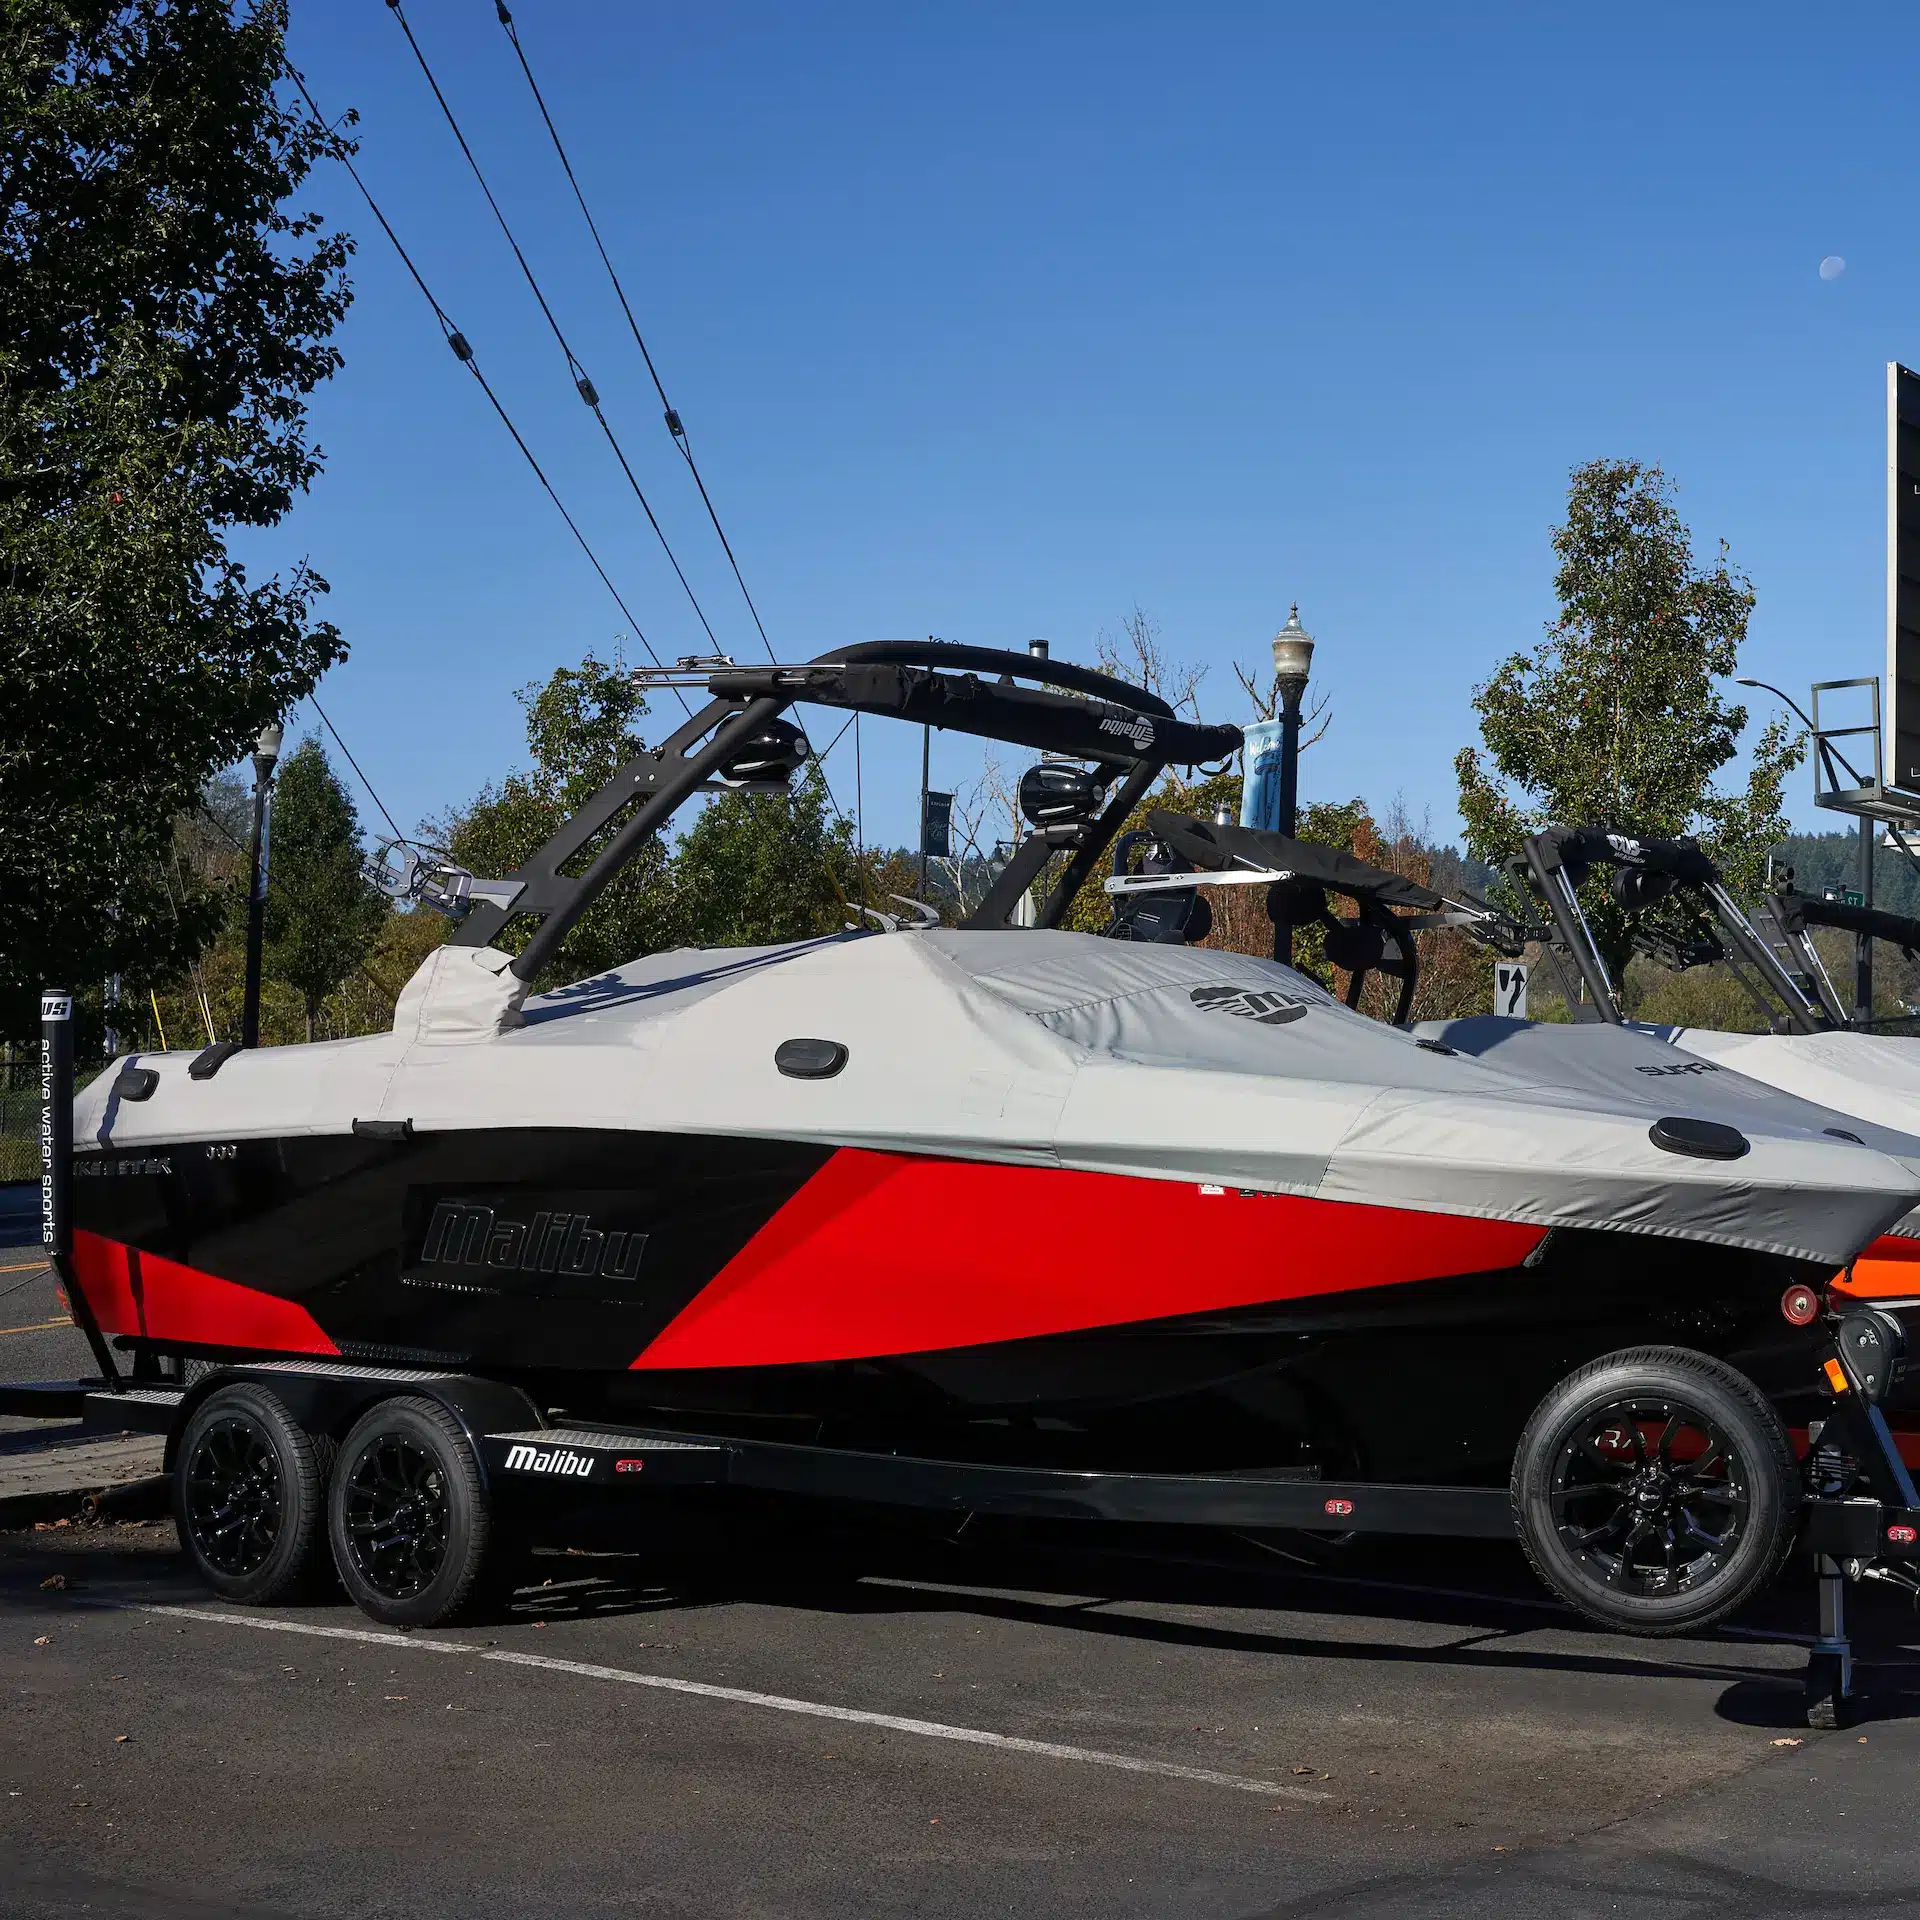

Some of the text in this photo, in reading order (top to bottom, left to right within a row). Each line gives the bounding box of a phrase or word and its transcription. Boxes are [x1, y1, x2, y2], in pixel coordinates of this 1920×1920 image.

[1099, 718, 1147, 740] Malibu
[41, 1038, 56, 1243] active water sports
[421, 1202, 649, 1281] Malibu
[504, 1445, 595, 1477] Malibu
